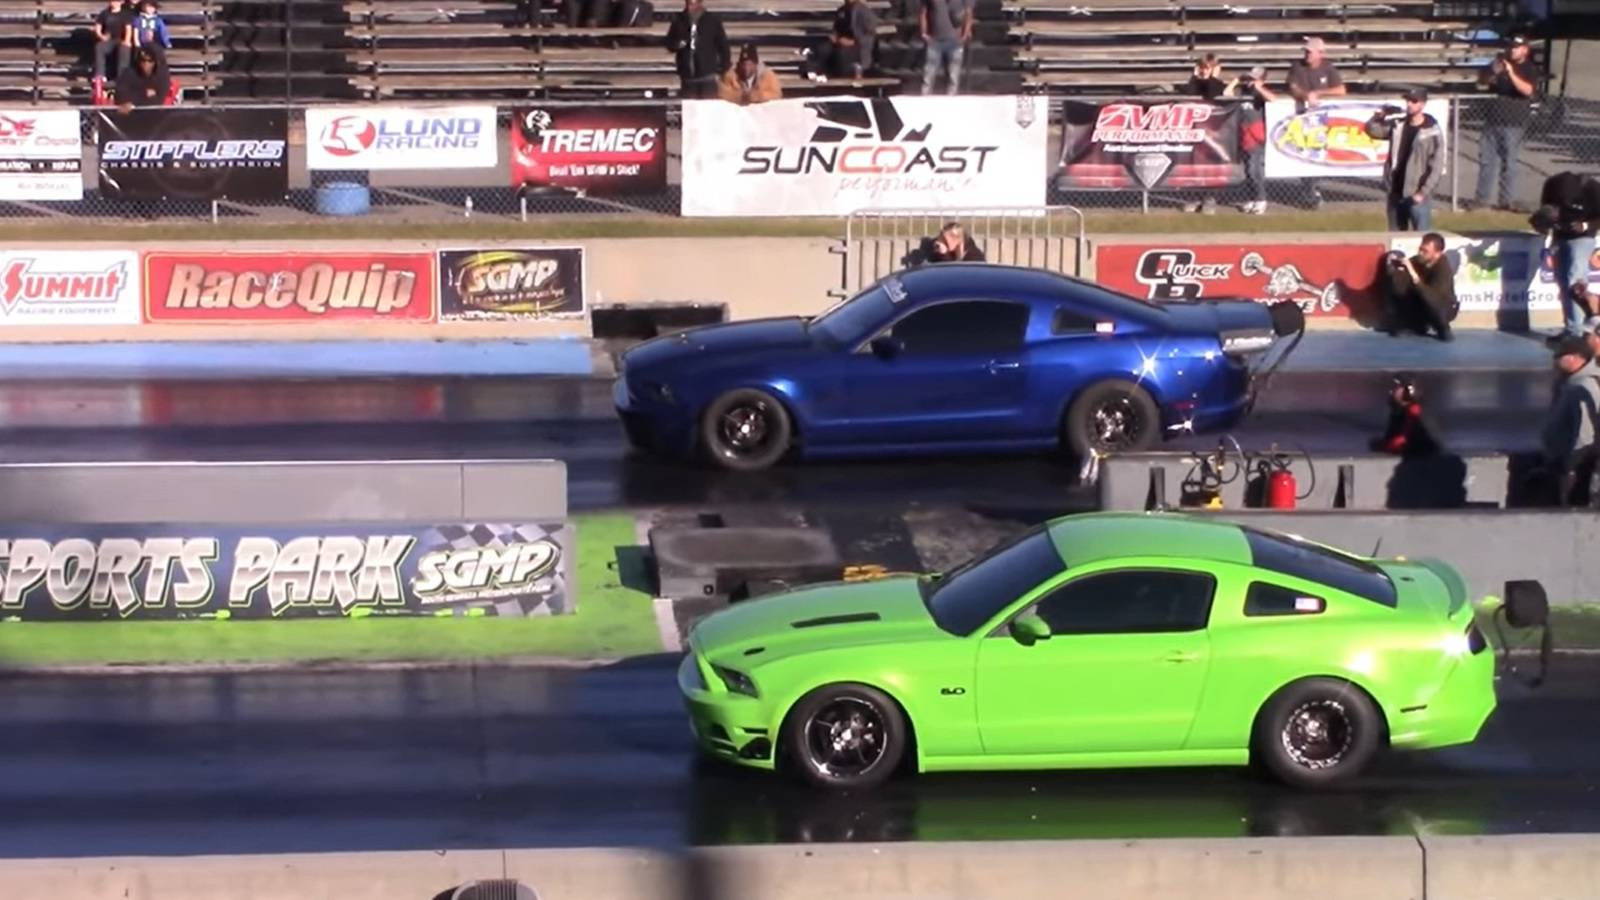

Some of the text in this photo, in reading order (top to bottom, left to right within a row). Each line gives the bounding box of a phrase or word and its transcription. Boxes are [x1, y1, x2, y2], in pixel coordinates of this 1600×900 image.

[378, 118, 481, 136] LUND
[538, 128, 657, 152] TREMEC
[1091, 129, 1206, 142] PERFORMANCE
[103, 141, 285, 160] STIFFLERS
[376, 136, 479, 150] RACING
[738, 146, 999, 174] SUNCOAST
[165, 263, 416, 313] RaceQuip
[467, 259, 559, 293] SGMP
[229, 536, 416, 616] PARK
[413, 541, 560, 598] SGMP
